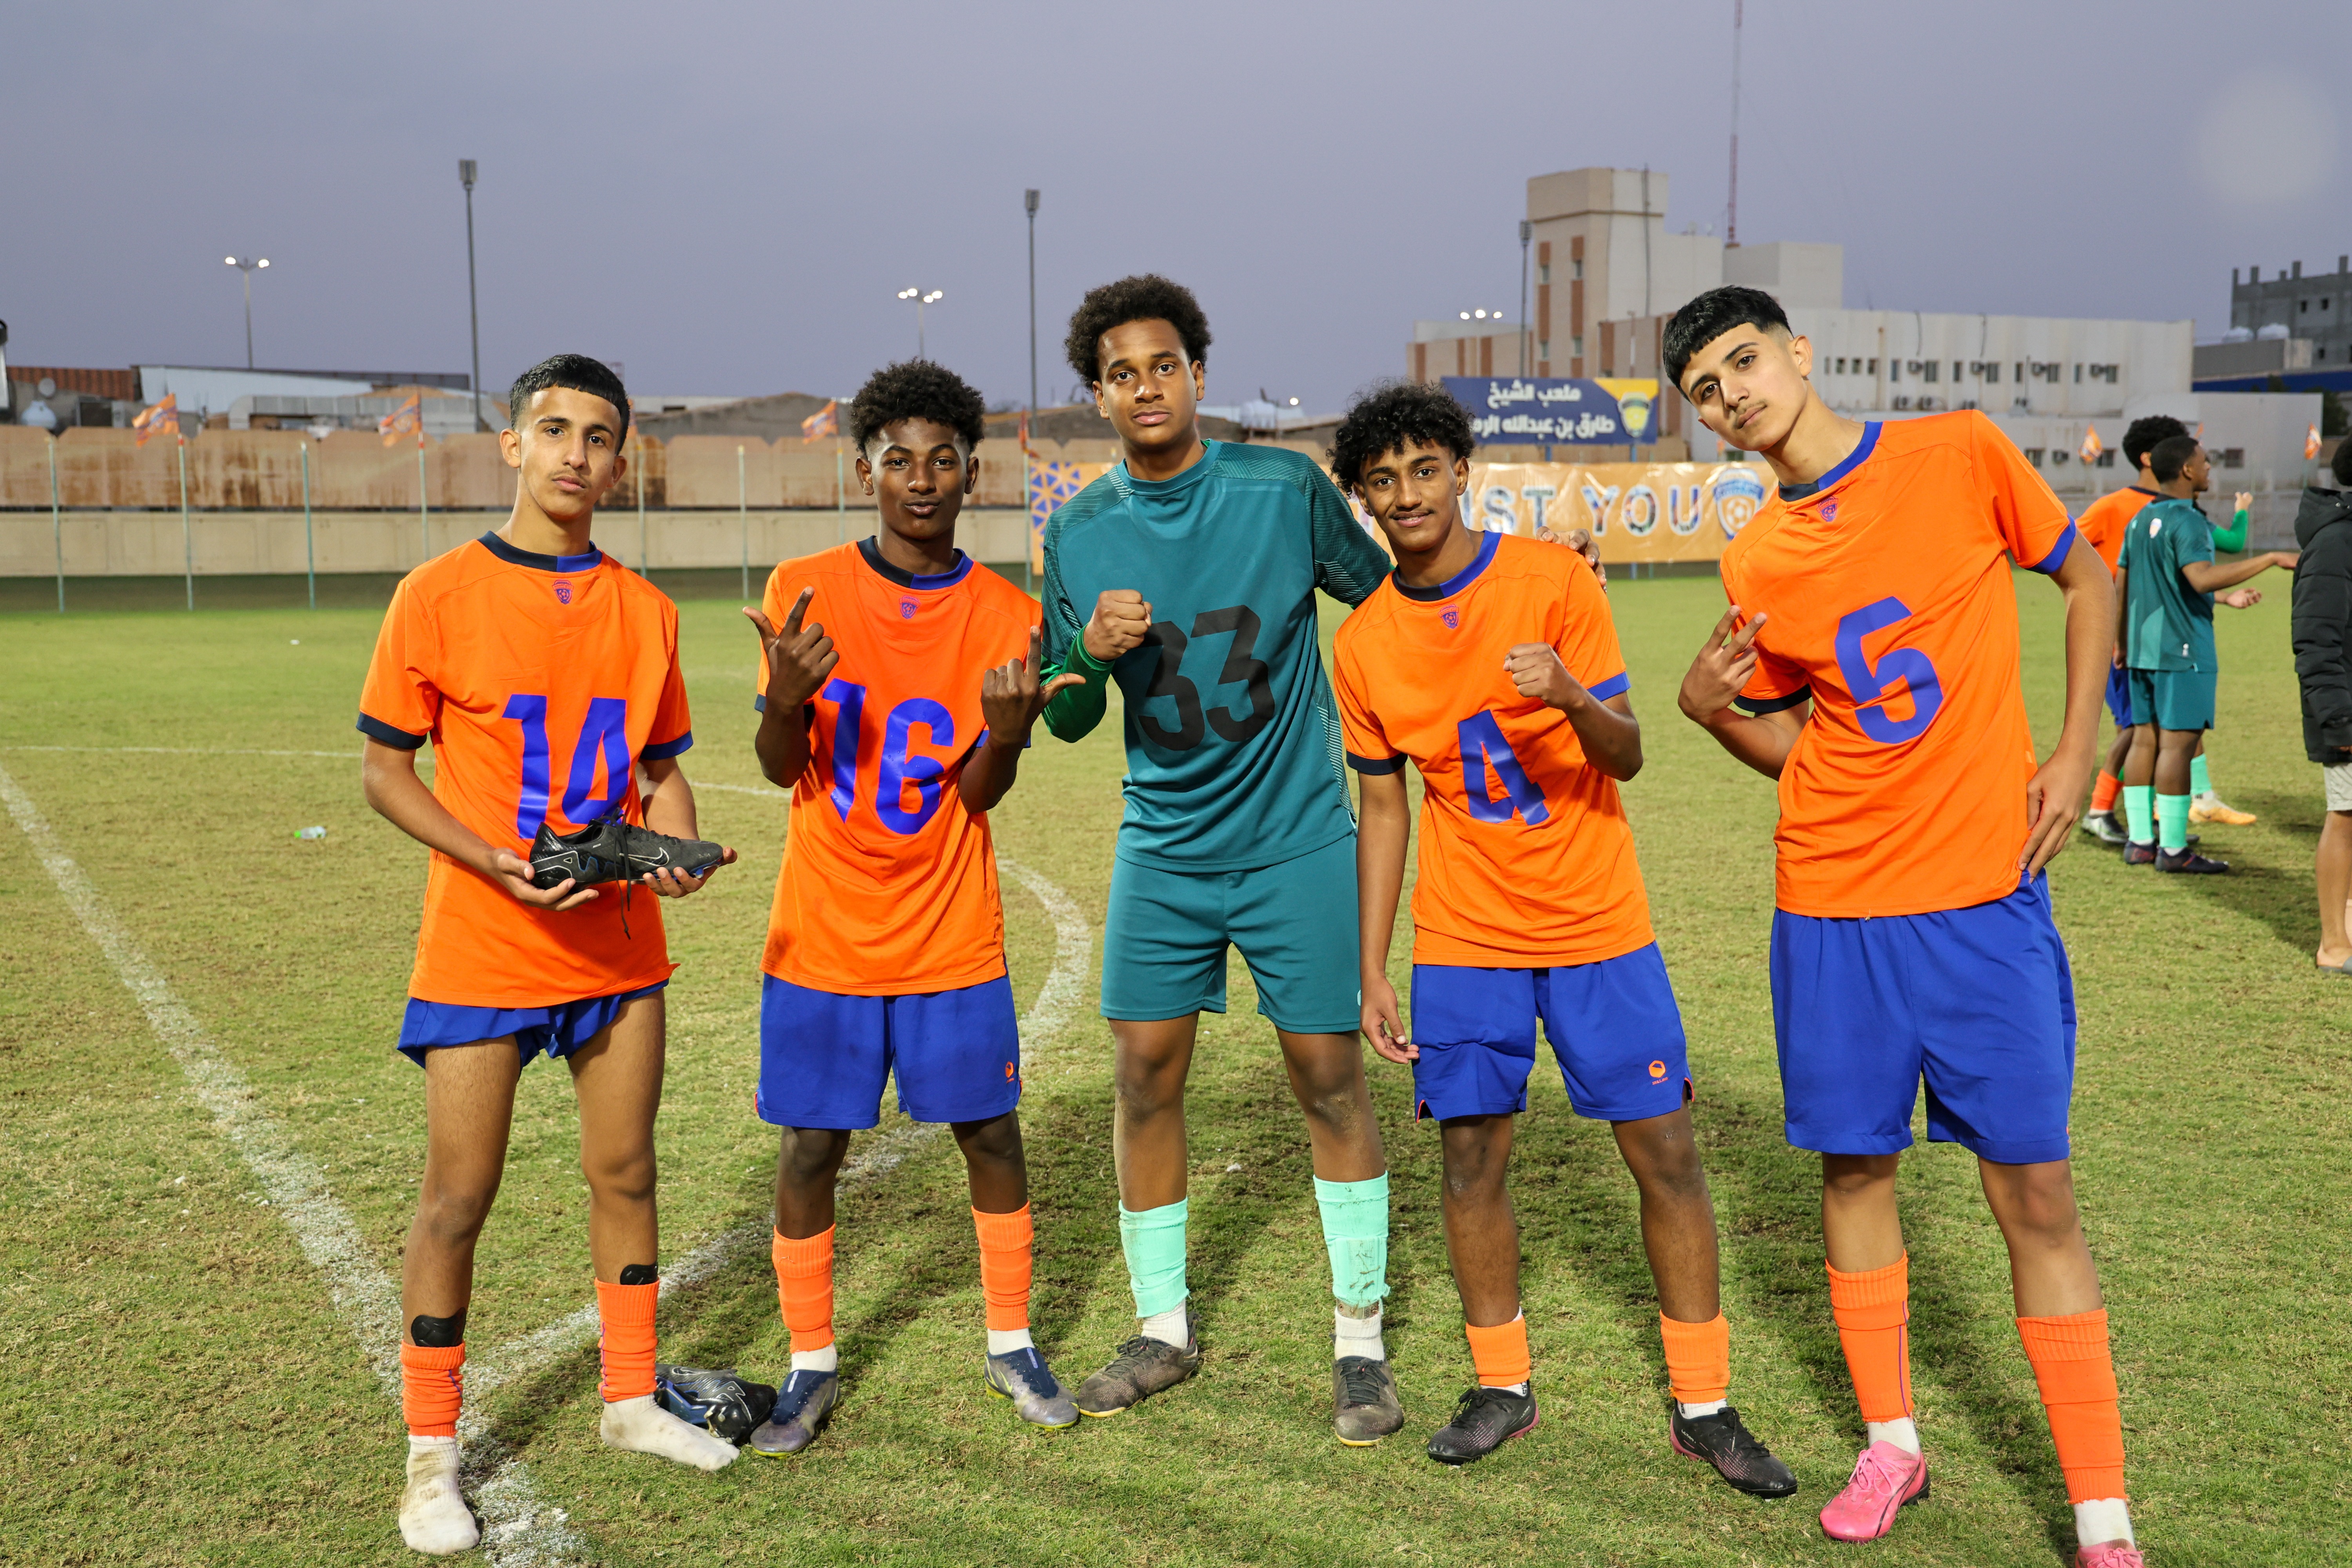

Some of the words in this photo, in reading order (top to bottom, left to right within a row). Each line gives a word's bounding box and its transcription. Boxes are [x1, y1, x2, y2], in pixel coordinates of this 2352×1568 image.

[1487, 379, 1535, 410] الشيخ
[1537, 384, 1582, 408] ملعب
[1501, 414, 1554, 440] عبدالله
[1555, 416, 1575, 440] بن
[1575, 412, 1616, 439] طارق
[1581, 485, 1704, 537] YOU
[1138, 604, 1275, 751] 33
[1834, 596, 1944, 744] 5
[501, 693, 631, 839] 14
[822, 678, 955, 835] 16
[1457, 709, 1550, 826] 4
